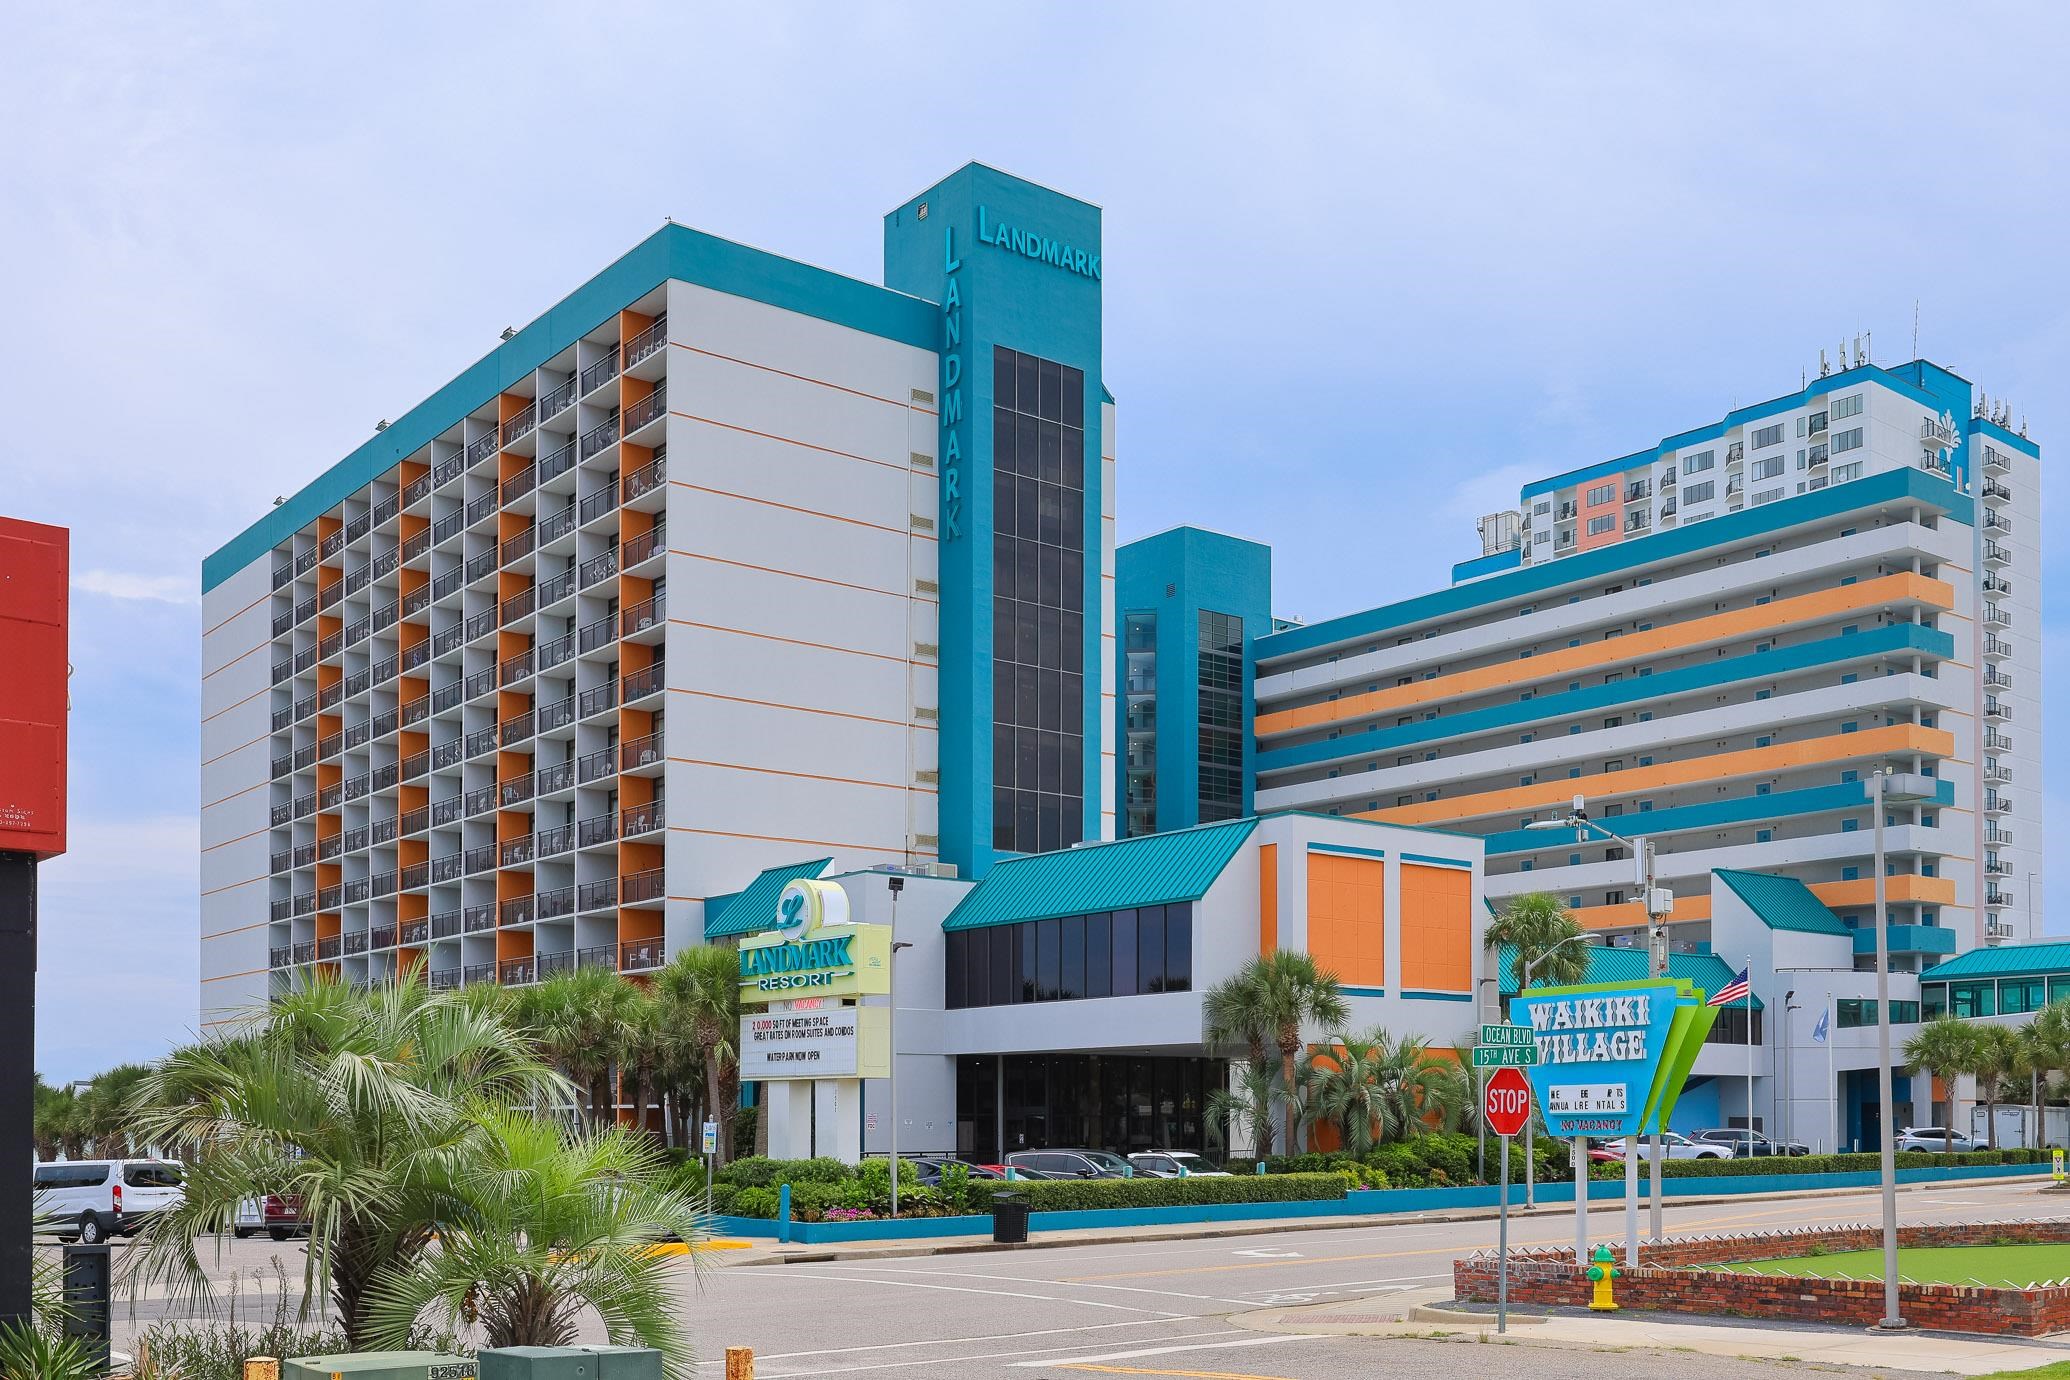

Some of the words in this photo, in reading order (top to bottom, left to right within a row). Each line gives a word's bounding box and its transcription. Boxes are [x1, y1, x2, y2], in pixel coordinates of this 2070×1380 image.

[979, 205, 1102, 280] LANDMARK
[944, 225, 962, 541] LANDMARK
[740, 938, 854, 976] LANDMARK
[758, 972, 832, 991] RESORT
[779, 1020, 785, 1028] FT
[786, 1019, 791, 1028] OF
[792, 1018, 811, 1028] MEETING
[812, 1016, 829, 1026] SPACE
[1528, 996, 1650, 1031] WAIKIKI
[754, 1031, 769, 1041] GREAT
[770, 1030, 784, 1040] RATES
[784, 1030, 791, 1039] ON
[792, 1029, 806, 1039] ROOM
[807, 1028, 823, 1038] SUITES
[824, 1027, 834, 1036] AND
[835, 1026, 854, 1036] CONDOS
[1486, 1027, 1510, 1044] OCEAN
[1513, 1028, 1532, 1044] BLVD
[808, 1051, 820, 1060] OPEN
[1535, 1031, 1647, 1064] VILLAGE
[1479, 1049, 1497, 1065] 15TH
[1502, 1049, 1521, 1064] AVE
[1525, 1049, 1532, 1064] S
[1488, 1088, 1527, 1114] STOP
[1561, 1119, 1575, 1132] NO
[430, 1364, 475, 1379] 92518
